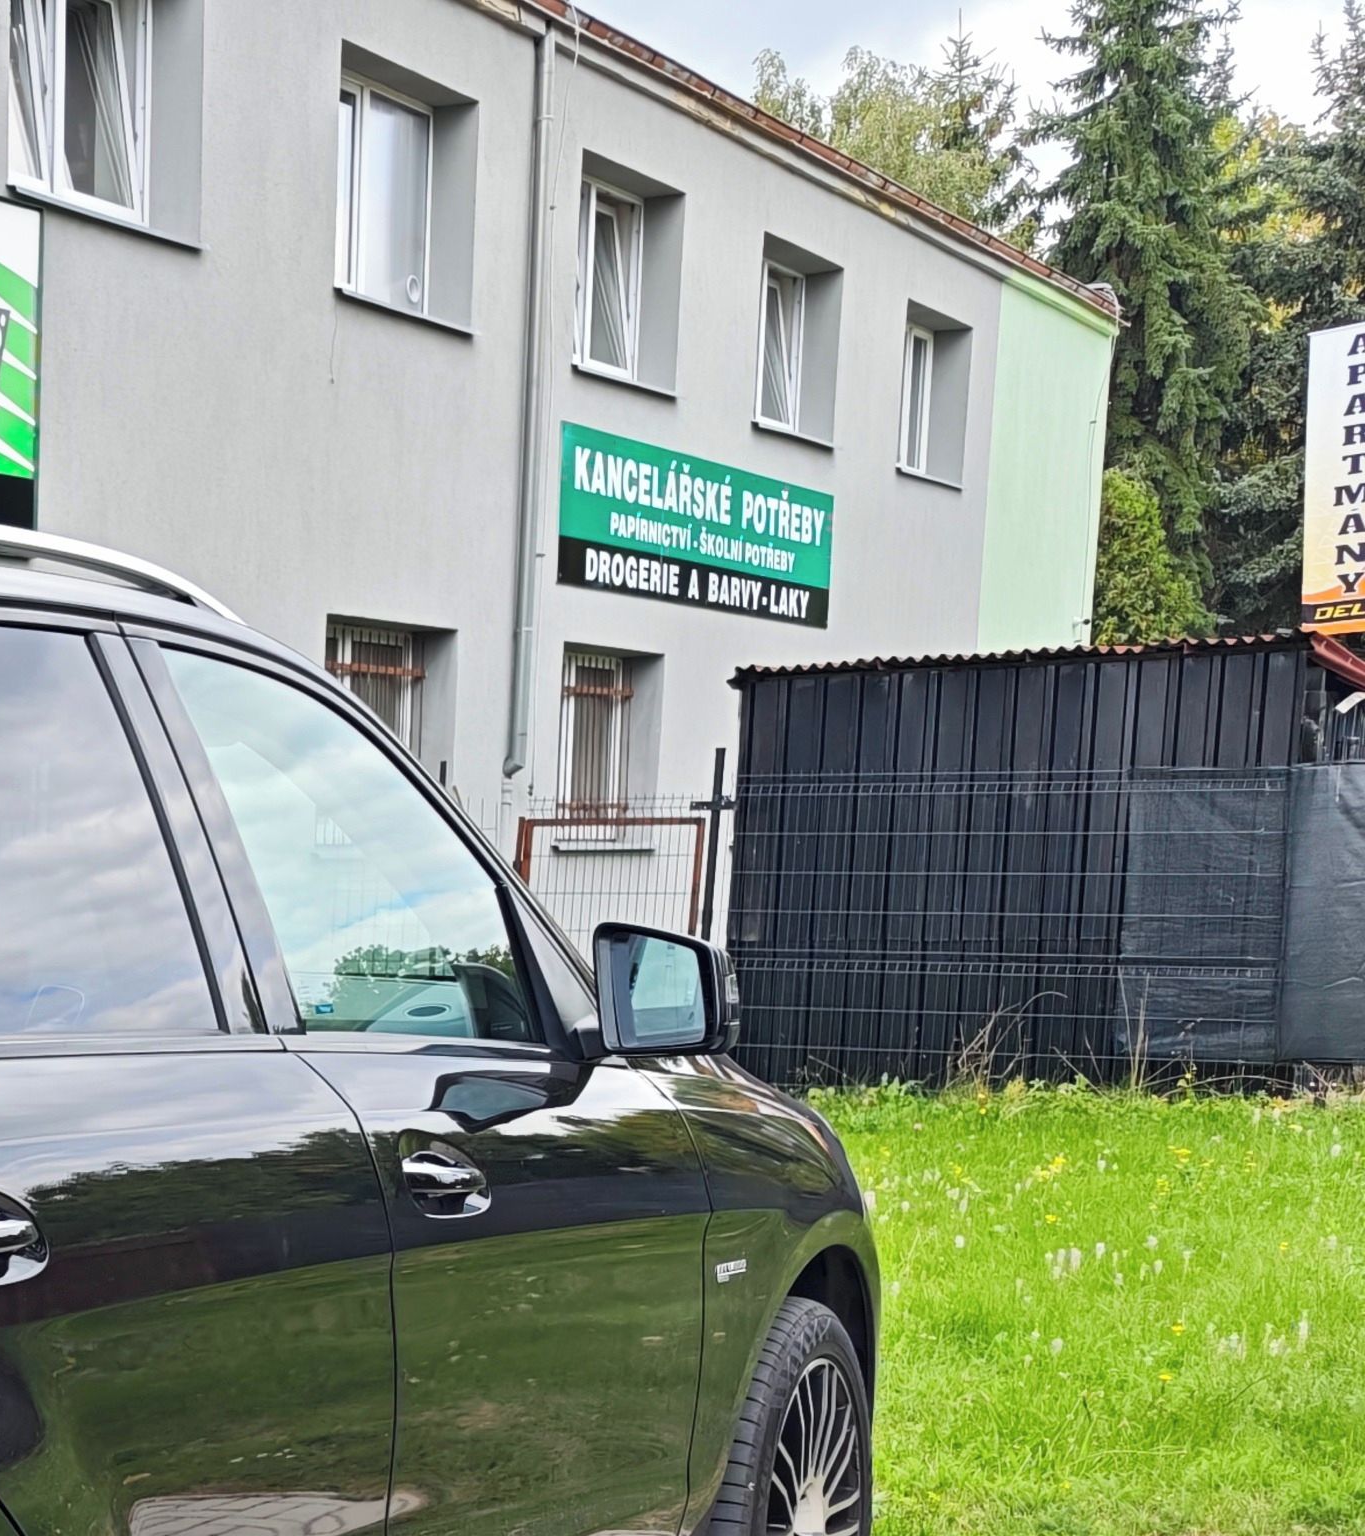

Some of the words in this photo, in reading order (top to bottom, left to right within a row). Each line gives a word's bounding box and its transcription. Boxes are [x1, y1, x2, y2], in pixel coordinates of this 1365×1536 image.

[574, 446, 732, 525] KANCELÁŘSKÉ
[742, 490, 825, 546] POTŘEBY
[585, 547, 680, 596] DROGERIE
[687, 568, 700, 600] A
[745, 541, 795, 573] POTŘEBY
